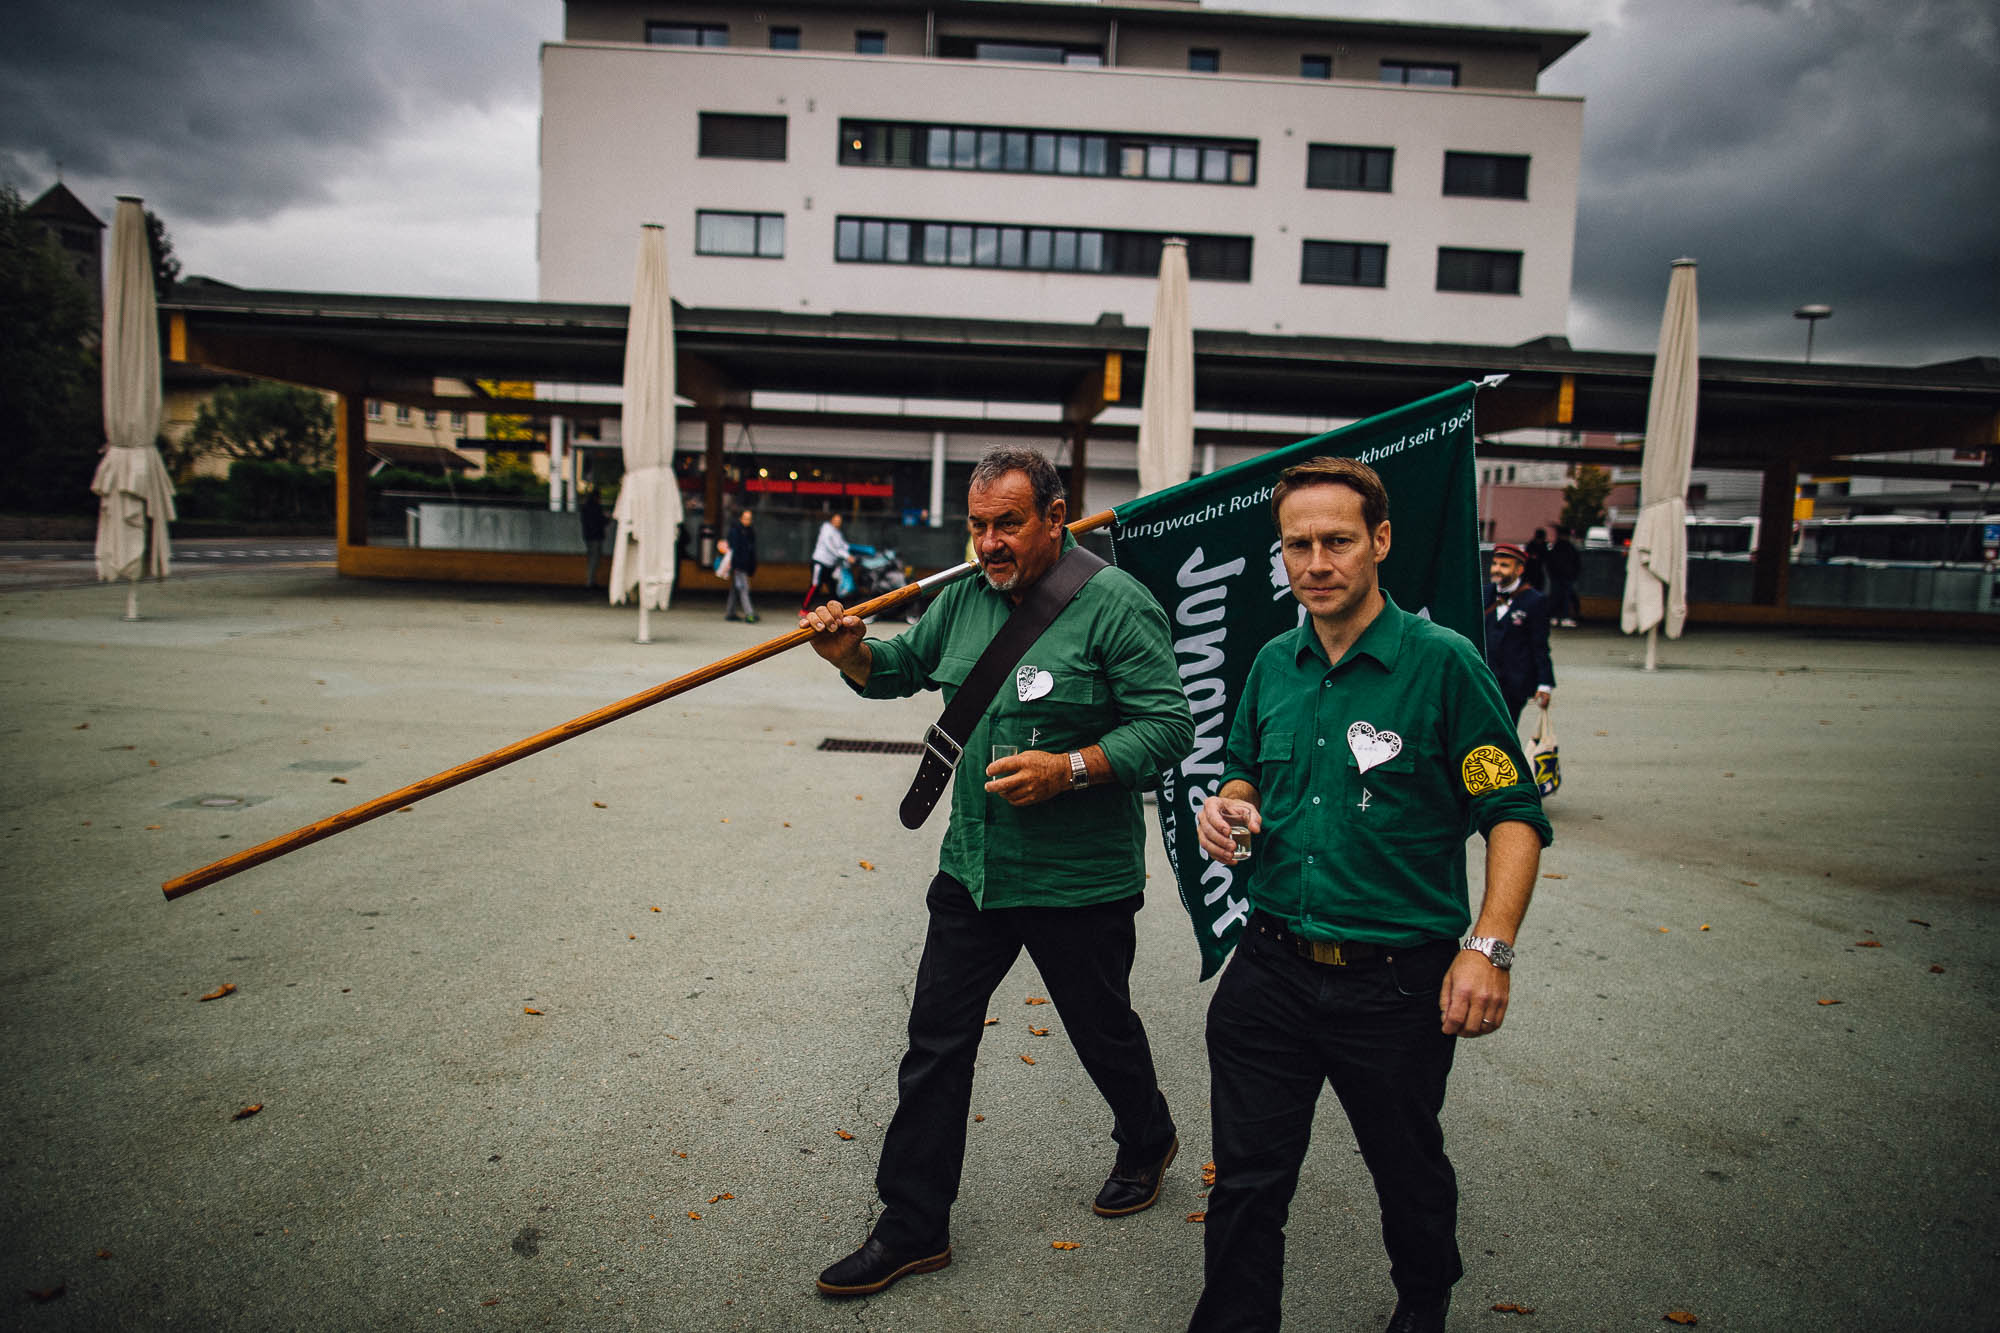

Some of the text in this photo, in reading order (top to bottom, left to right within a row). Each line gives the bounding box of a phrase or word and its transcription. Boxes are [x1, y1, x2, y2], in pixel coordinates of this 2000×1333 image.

[1117, 503, 1226, 541] Jungwacht
[1407, 427, 1437, 448] seit
[1162, 767, 1176, 802] ND
